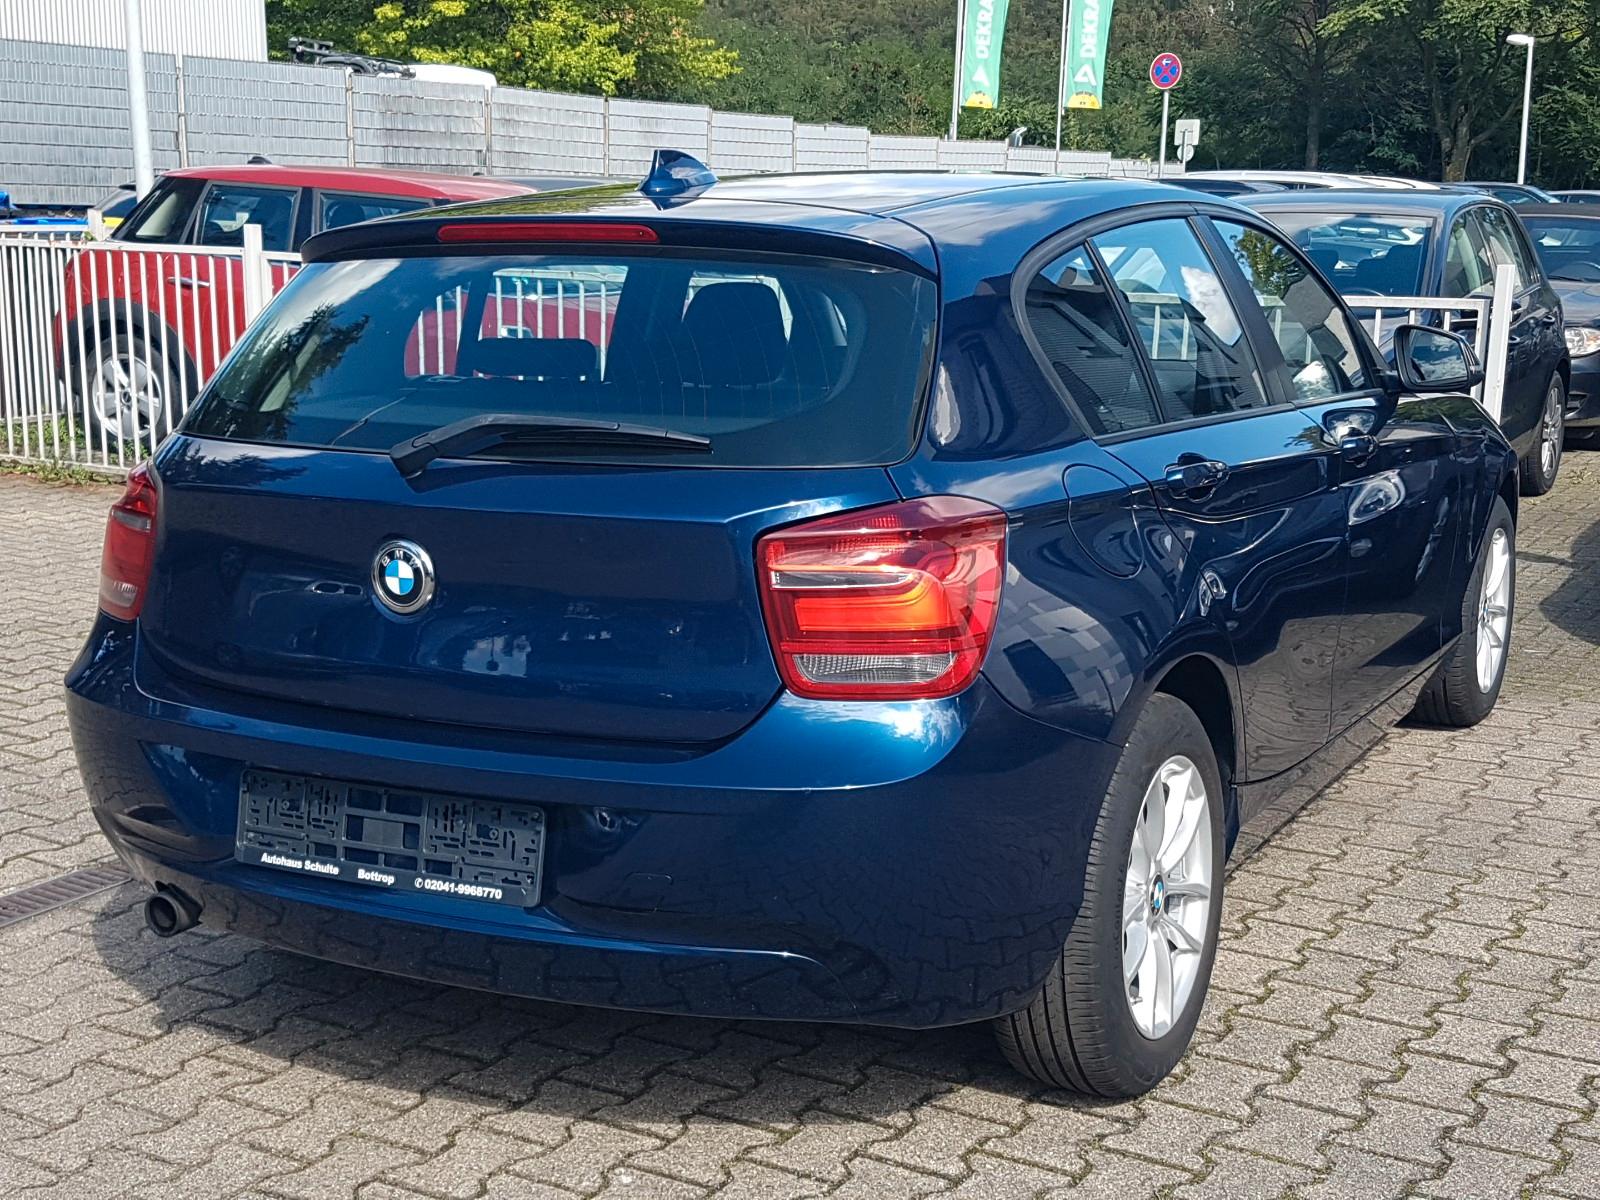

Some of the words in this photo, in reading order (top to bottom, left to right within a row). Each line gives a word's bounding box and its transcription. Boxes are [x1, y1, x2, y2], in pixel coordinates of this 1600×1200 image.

[975, 0, 994, 59] DEKRA
[381, 549, 420, 569] BMW
[260, 852, 303, 869] Autohaus
[304, 860, 340, 875] Schulte
[357, 868, 395, 885] Bottrop
[424, 878, 503, 899] 02041-9968770
